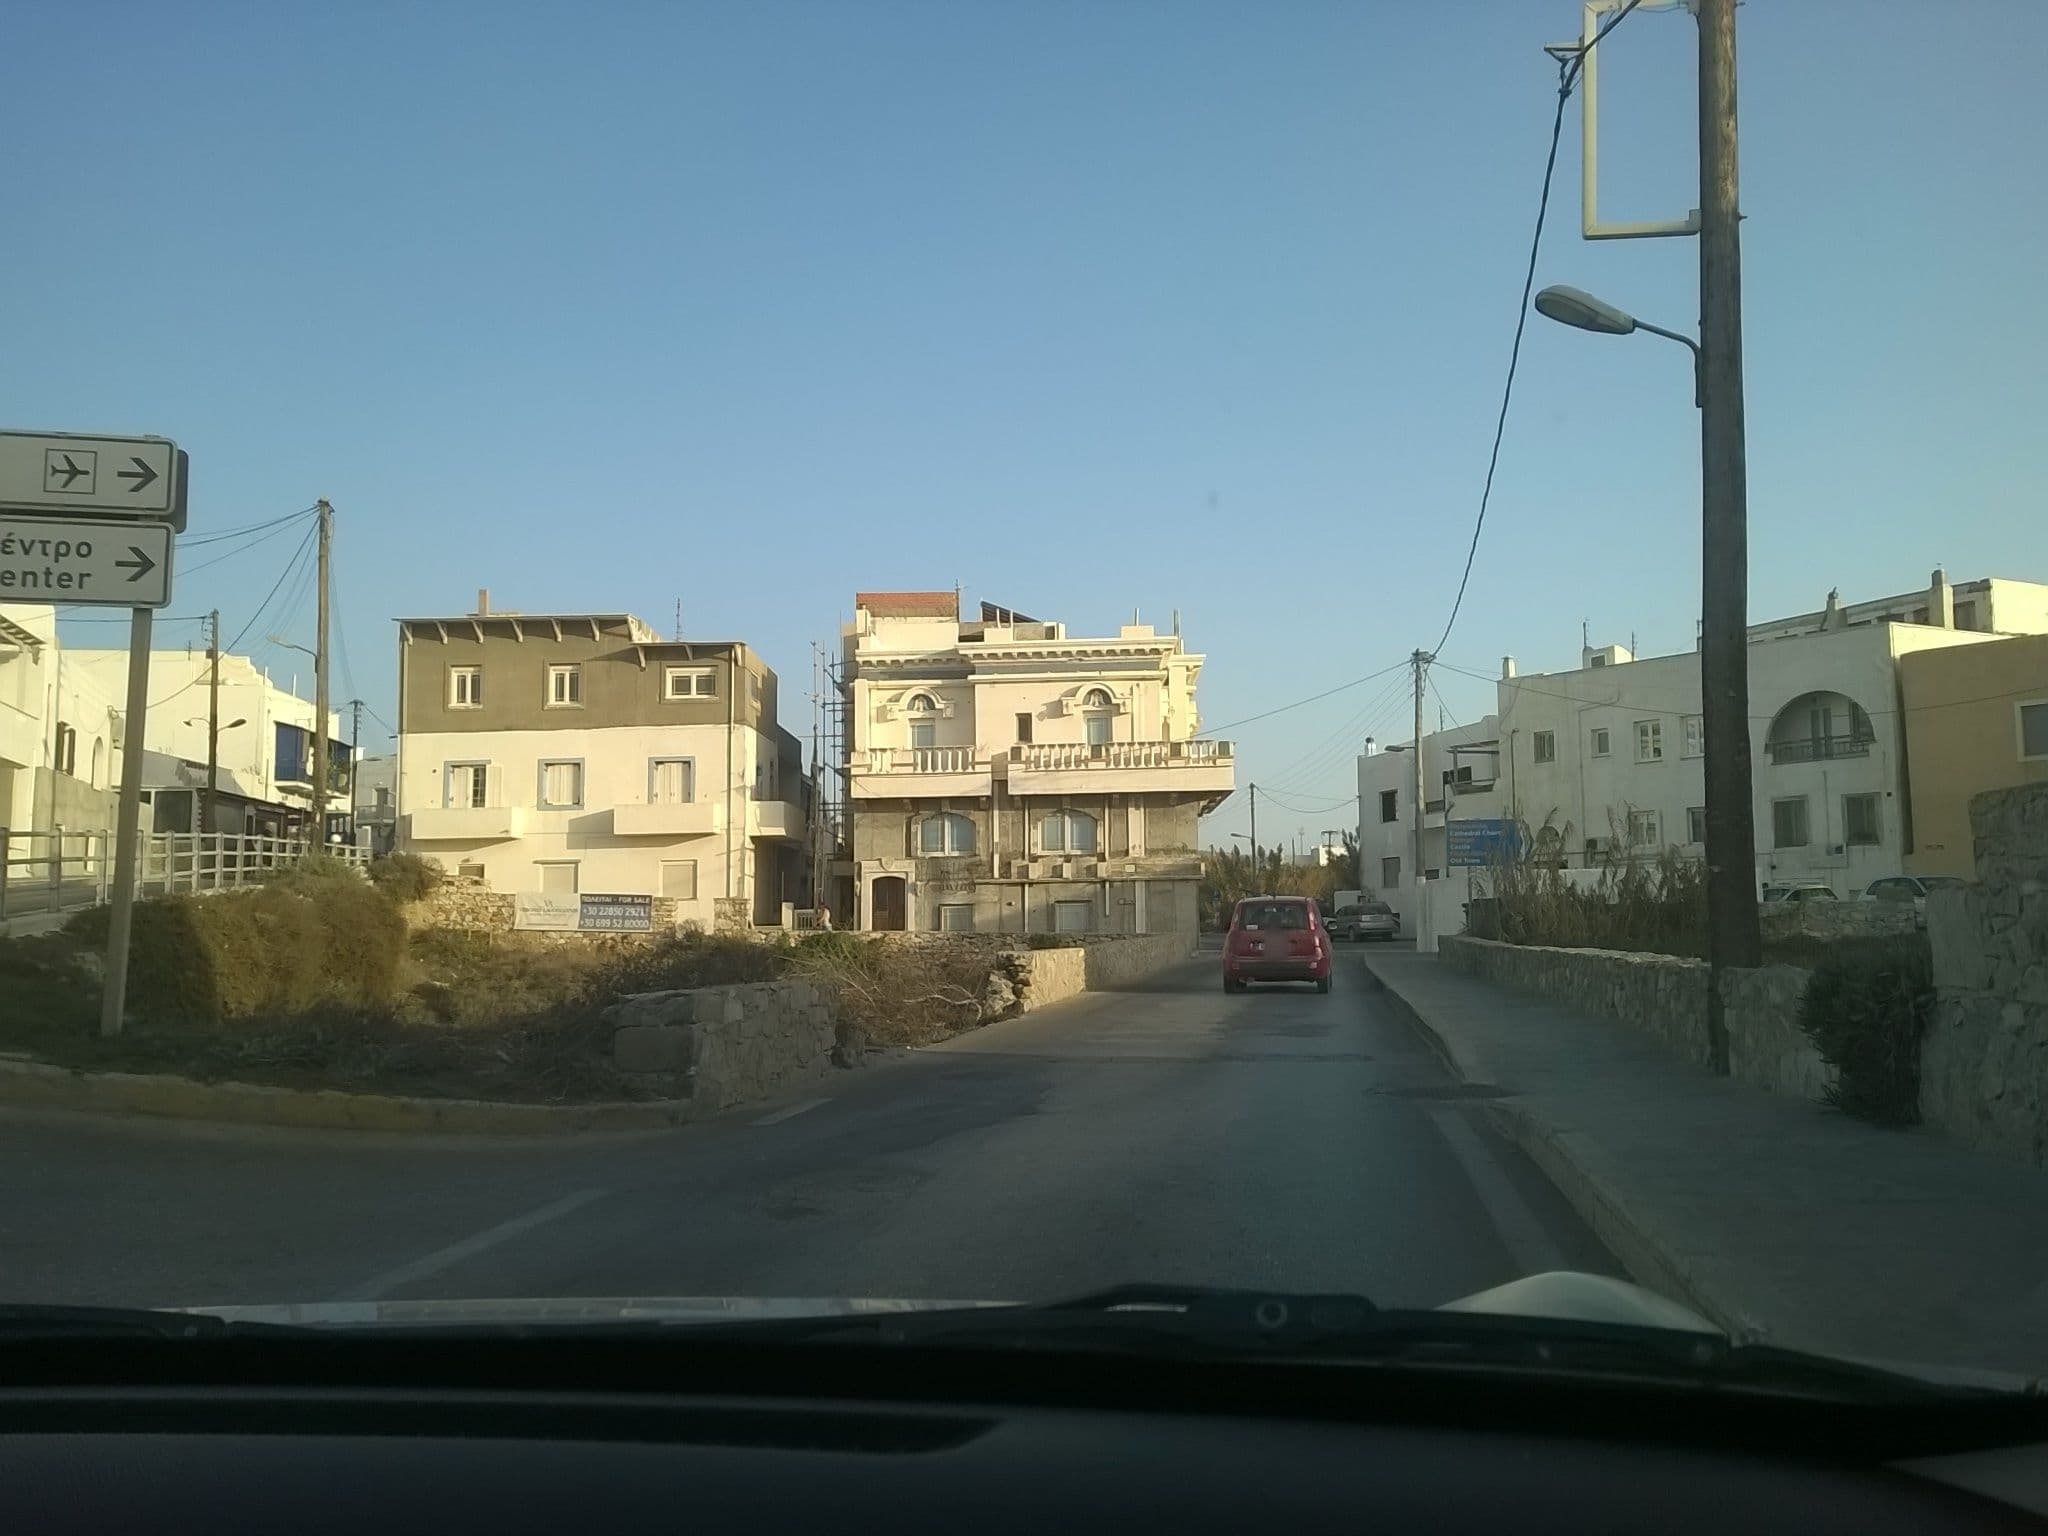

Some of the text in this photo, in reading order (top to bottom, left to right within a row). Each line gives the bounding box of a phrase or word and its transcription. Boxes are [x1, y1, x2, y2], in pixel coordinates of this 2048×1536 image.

[0, 532, 93, 563] έντρο
[0, 567, 92, 589] enter
[618, 896, 632, 904] FOR
[633, 897, 651, 905] SALE
[583, 906, 598, 916] +30
[599, 906, 624, 916] 22850
[580, 918, 595, 927] +30
